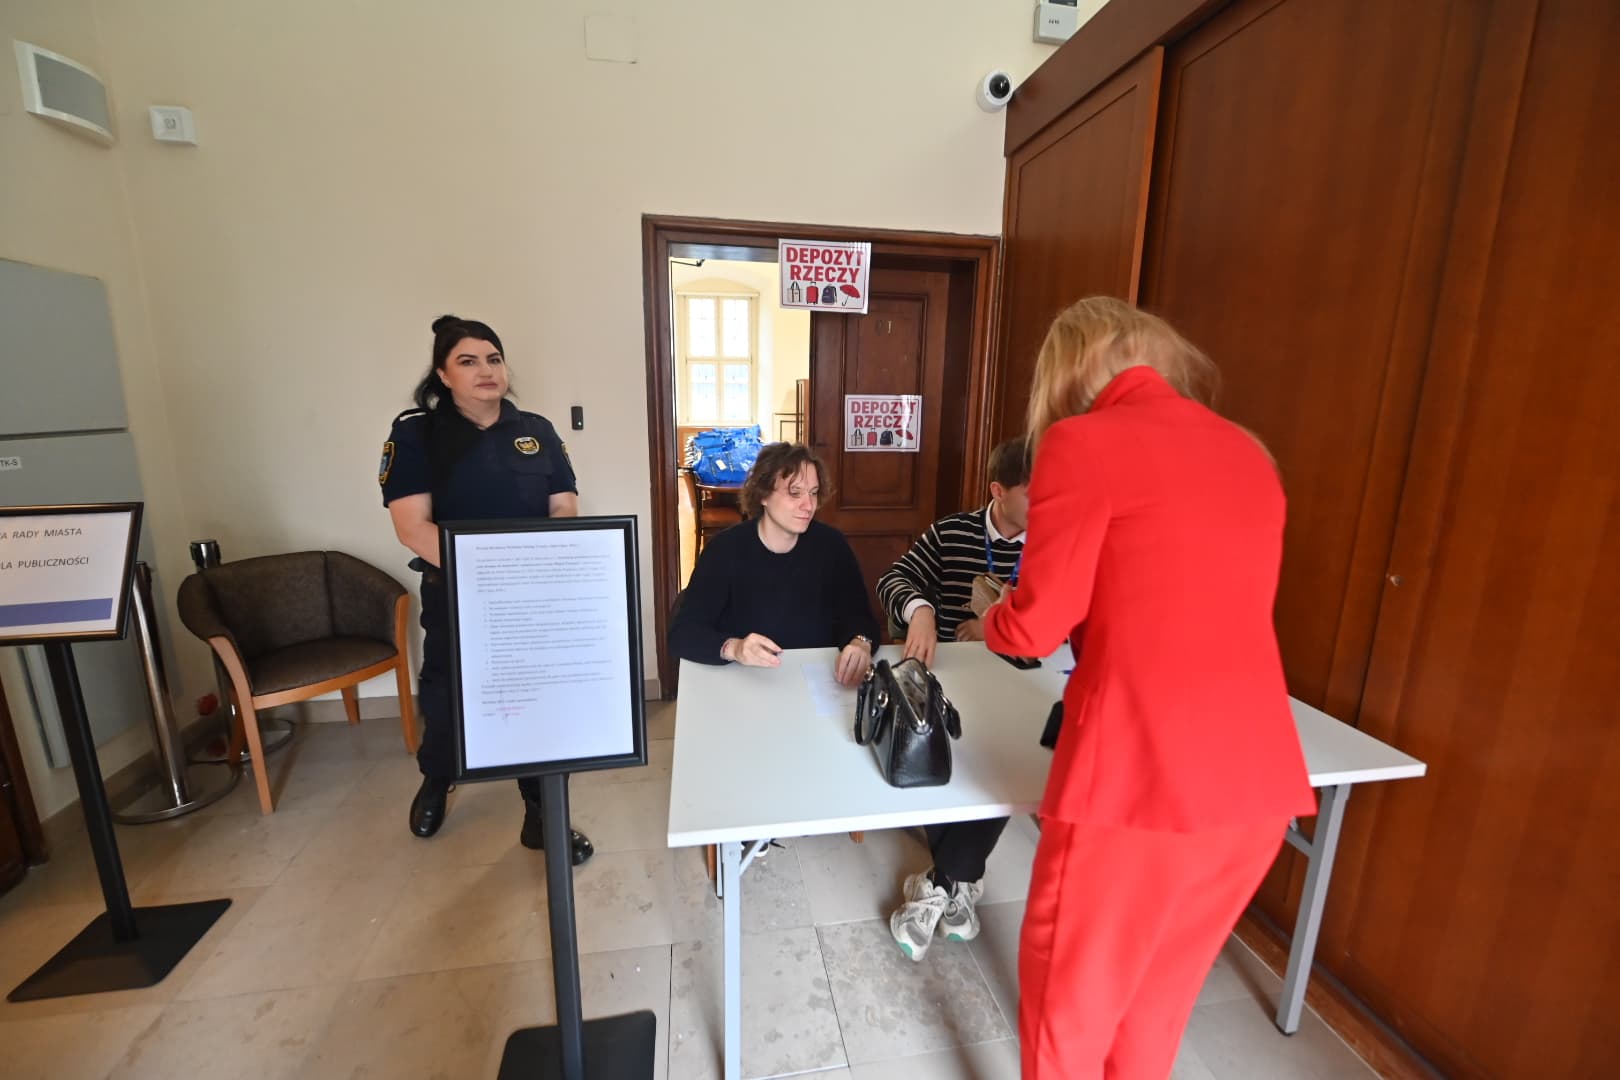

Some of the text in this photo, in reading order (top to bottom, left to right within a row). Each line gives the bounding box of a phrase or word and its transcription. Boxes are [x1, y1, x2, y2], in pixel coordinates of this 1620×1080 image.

[786, 247, 863, 266] DEPOZYT
[790, 264, 859, 283] RZECZY
[12, 530, 40, 539] RADY
[44, 528, 82, 537] MIASTA
[18, 556, 89, 568] PUBLICZNOŚCI
